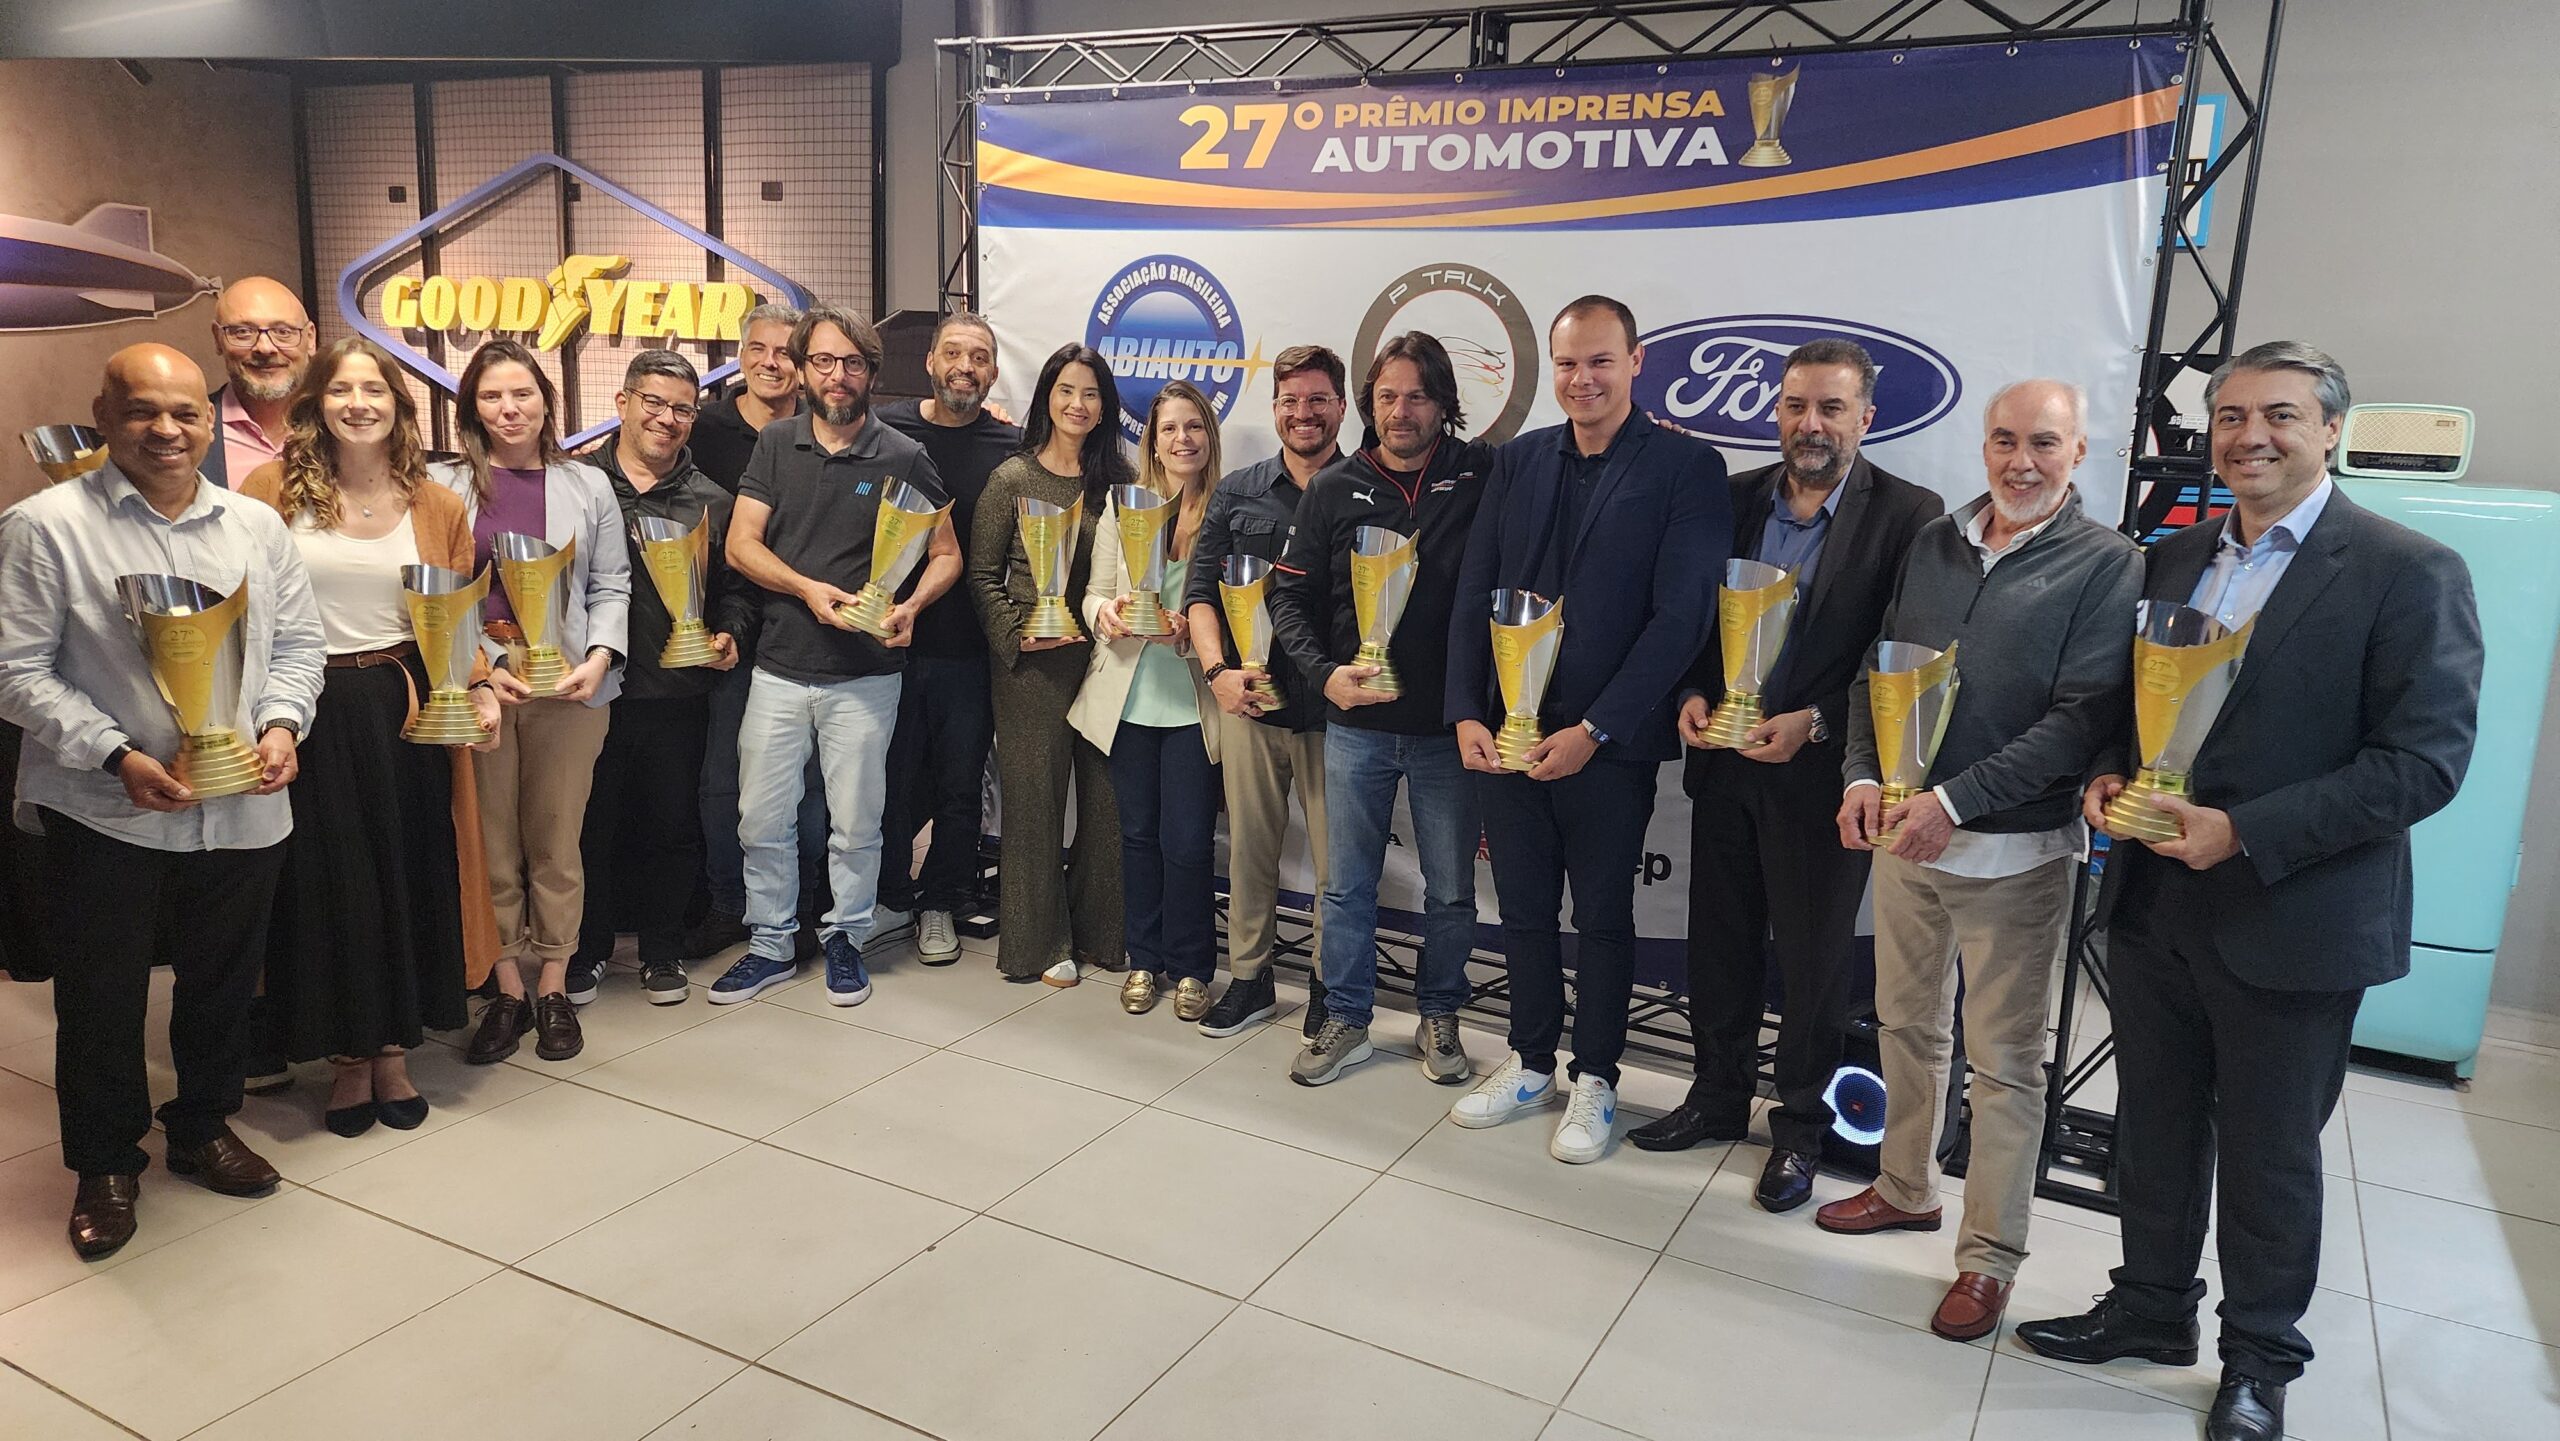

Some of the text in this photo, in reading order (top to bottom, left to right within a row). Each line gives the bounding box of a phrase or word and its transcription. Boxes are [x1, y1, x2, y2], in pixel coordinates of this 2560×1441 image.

[1335, 94, 1486, 129] PRÊMIO
[1499, 90, 1726, 124] IMPRENSA
[1311, 126, 1729, 175] AUTOMOTIVA
[1097, 262, 1233, 329] ASSOCIAÇÃO BRASILEIRA
[1422, 270, 1507, 307] TALK
[1097, 336, 1239, 384] ABIAUTO
